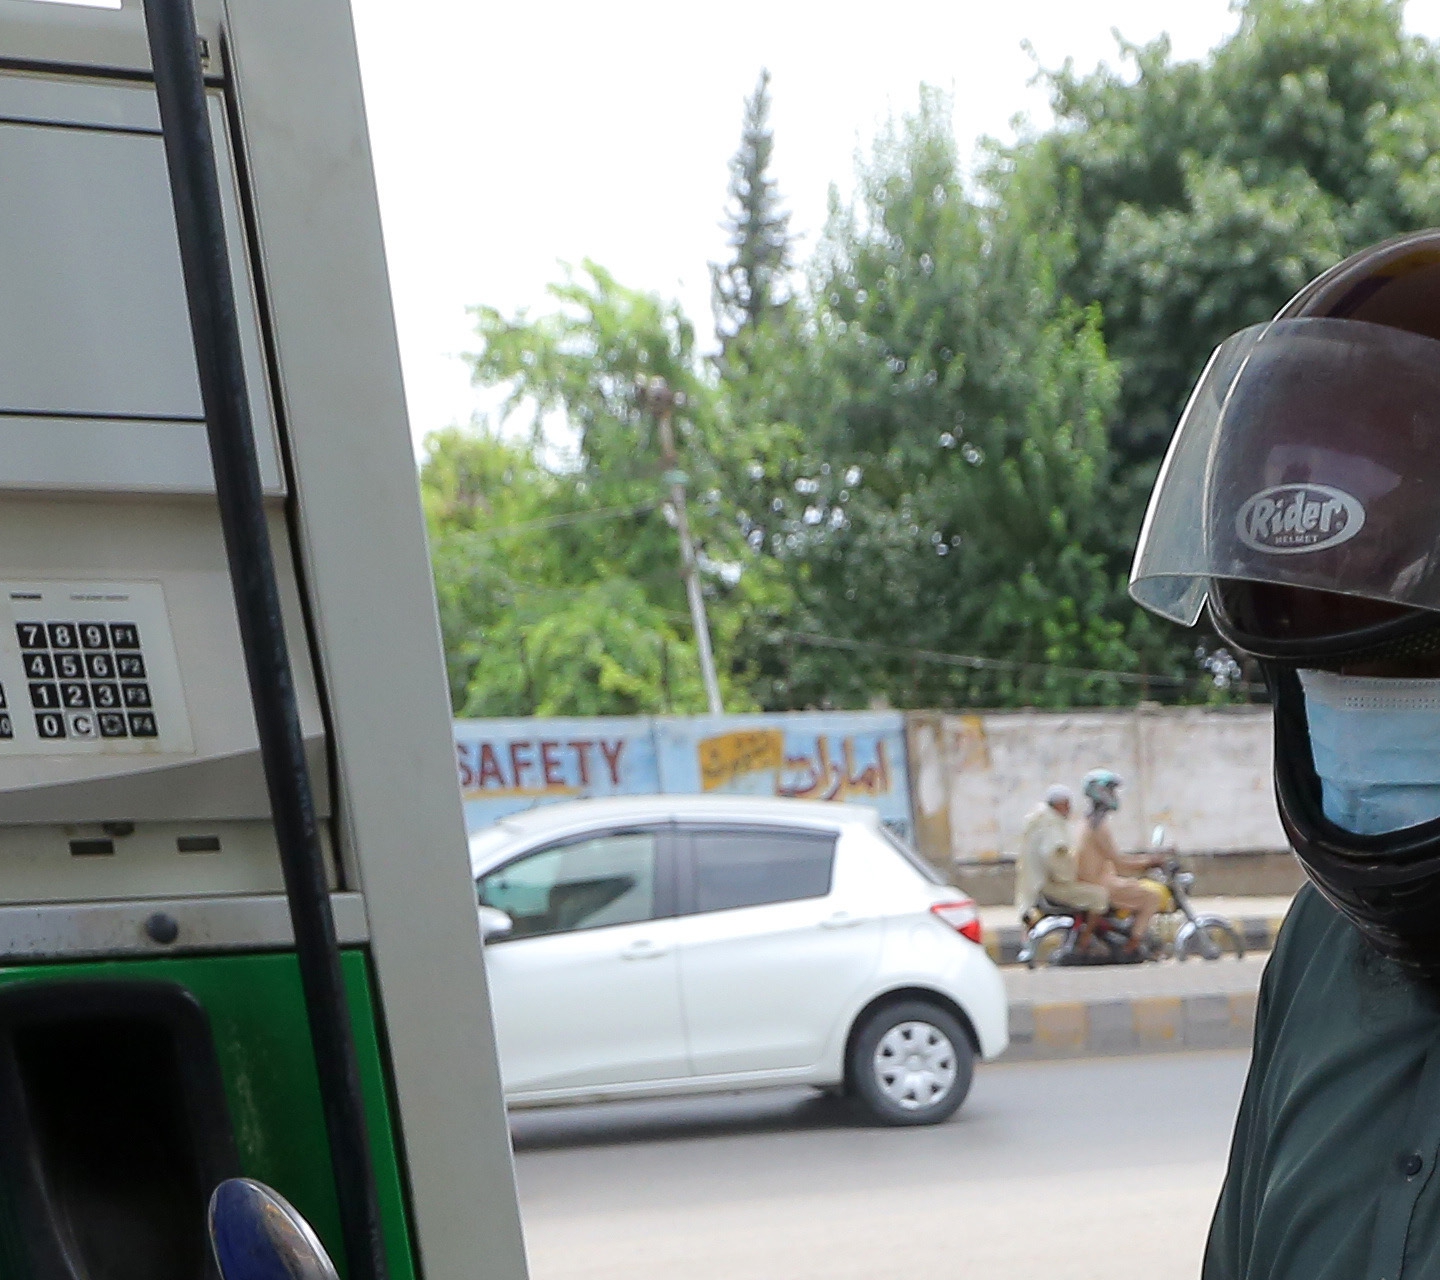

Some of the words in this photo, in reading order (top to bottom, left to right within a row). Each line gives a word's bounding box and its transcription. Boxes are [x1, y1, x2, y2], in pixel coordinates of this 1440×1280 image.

[1249, 491, 1344, 540] Rider
[23, 625, 38, 646] 7
[55, 625, 71, 647] 8
[86, 625, 102, 647] 9
[31, 655, 46, 676] 4
[62, 655, 77, 677] 5
[92, 655, 108, 677] 6
[38, 685, 50, 706] 1
[67, 685, 84, 706] 2
[98, 685, 114, 707] 3
[73, 717, 91, 735] C
